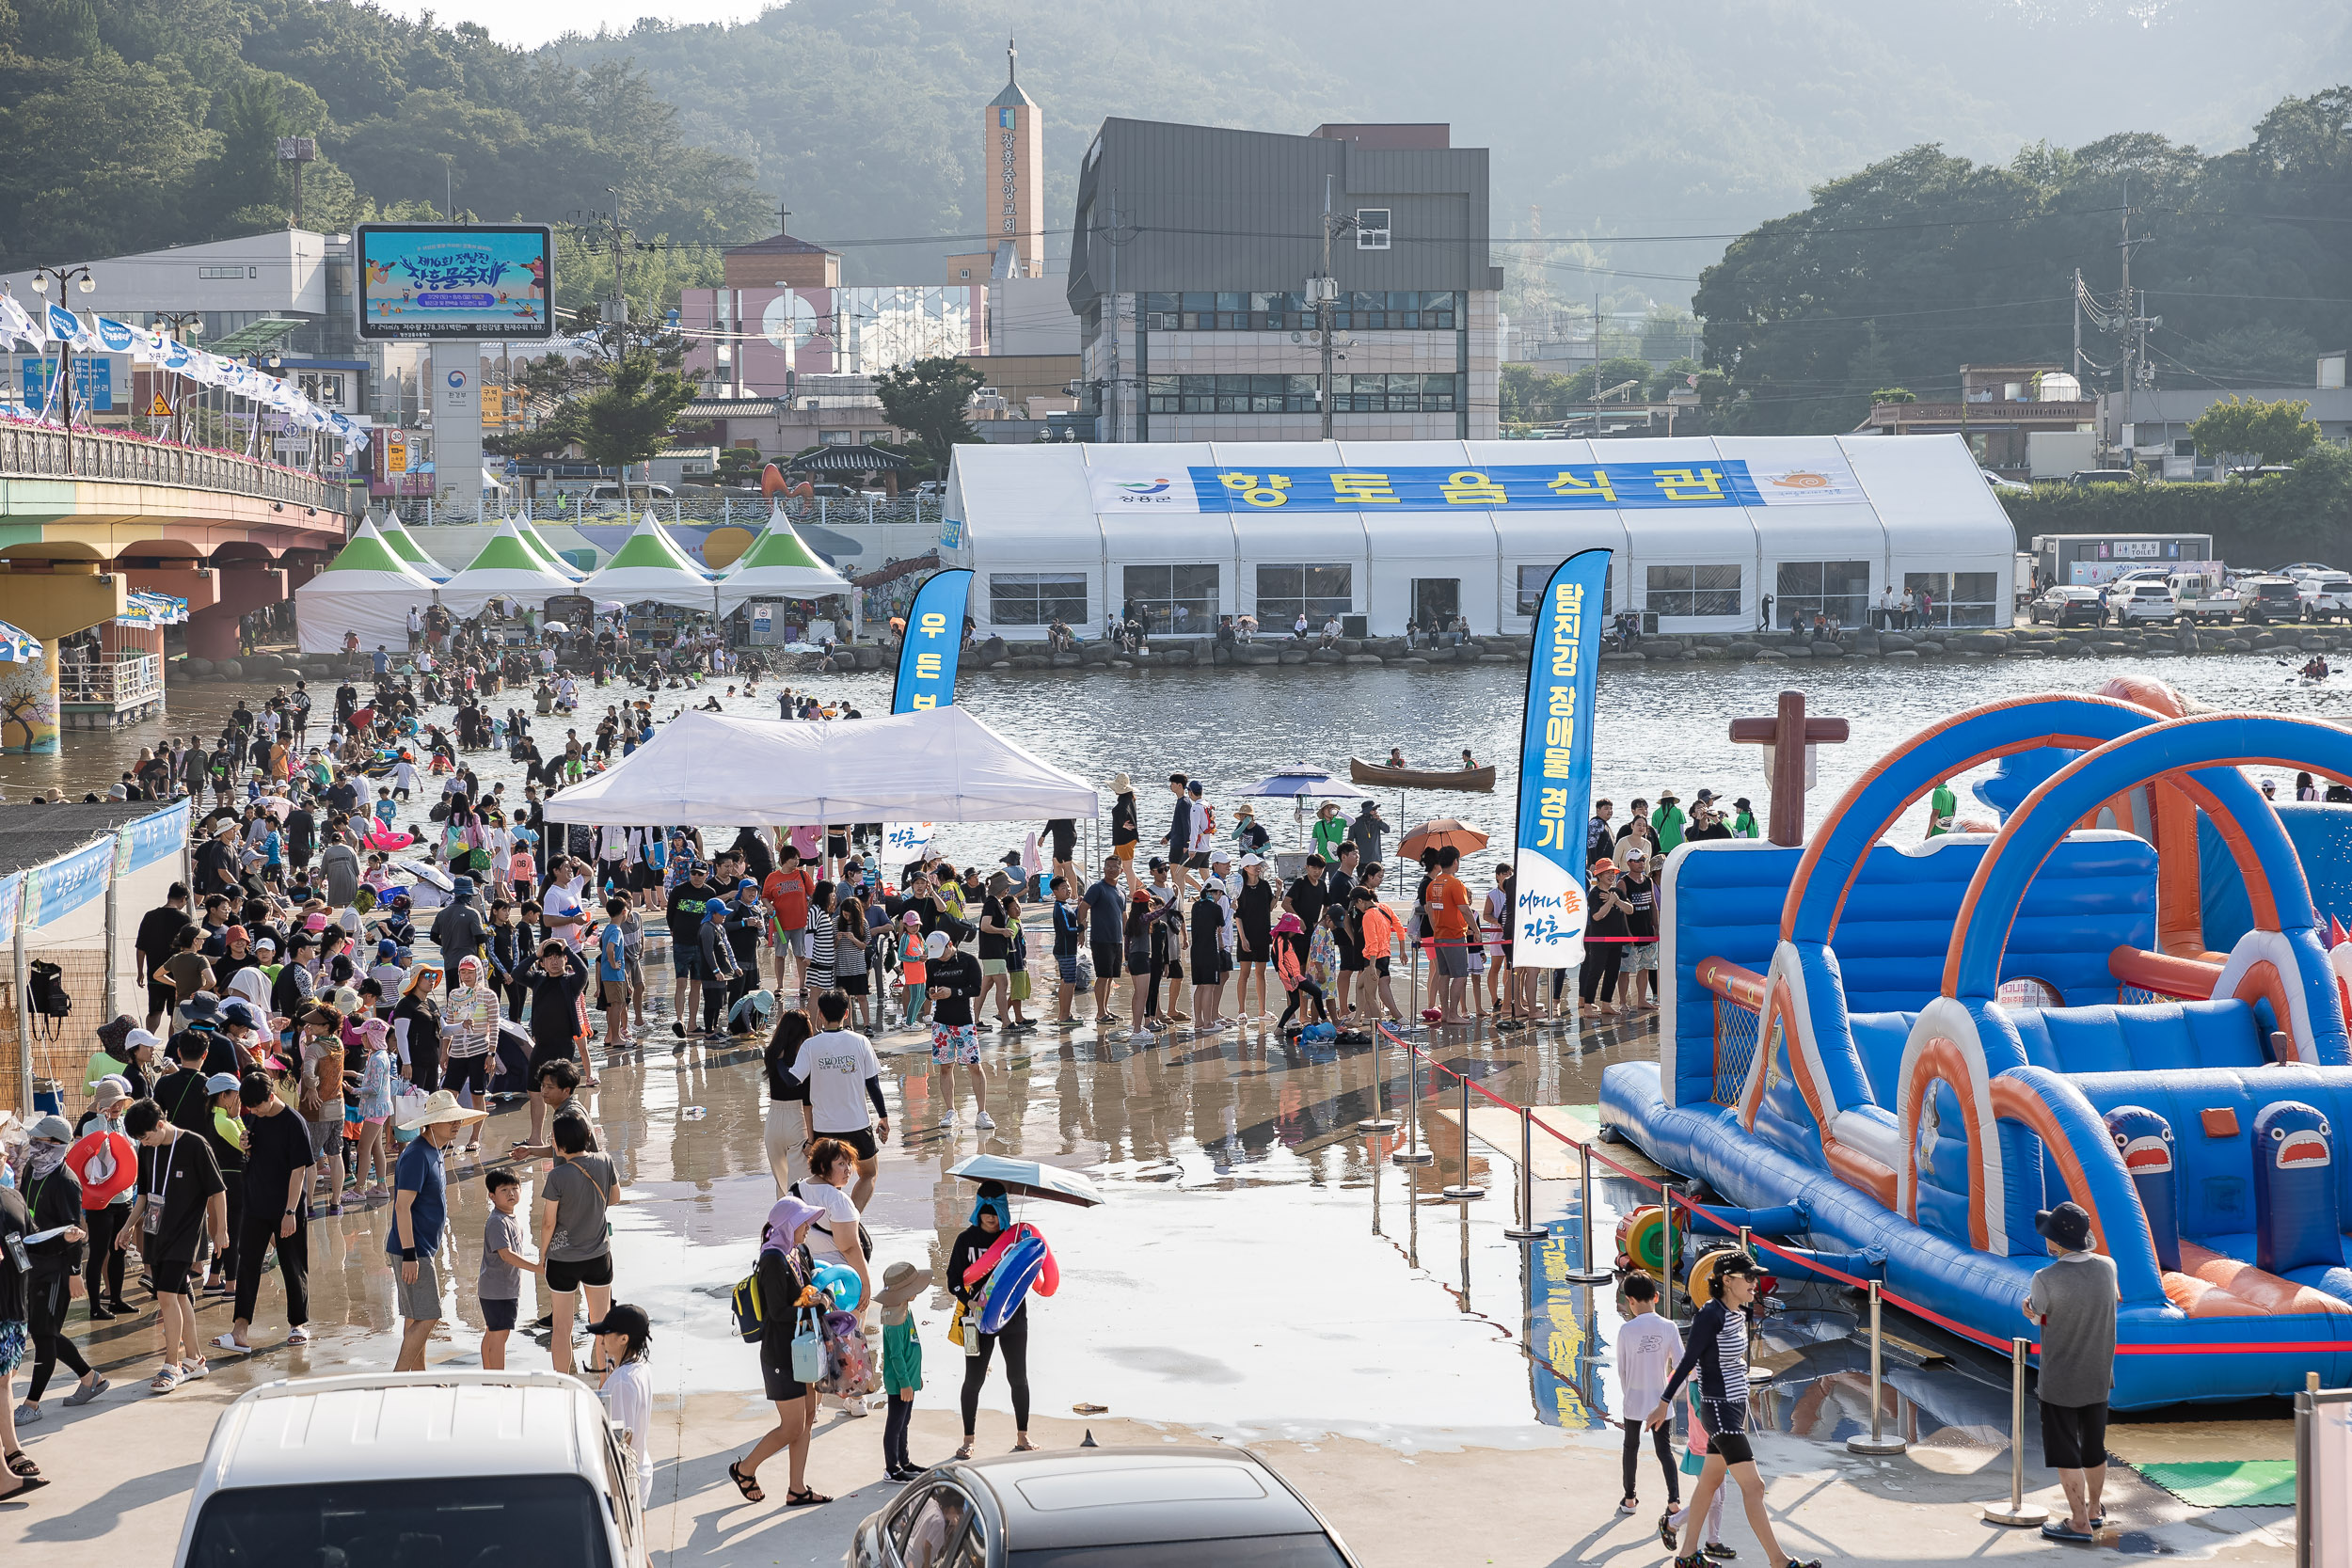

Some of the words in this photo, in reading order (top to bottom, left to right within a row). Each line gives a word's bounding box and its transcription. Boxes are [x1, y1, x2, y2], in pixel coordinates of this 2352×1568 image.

[1001, 134, 1016, 234] 장흥중앙교회
[455, 252, 489, 264] 정남진
[405, 260, 502, 292] 장흥물축제
[1551, 582, 1584, 677] 탐진강
[1543, 686, 1577, 779] 장애물
[1536, 787, 1567, 850] 경기
[889, 827, 930, 849] 장흥
[1518, 889, 1561, 919] 어머니
[1562, 889, 1581, 914] 품
[1523, 917, 1581, 946] 장흥
[818, 1054, 856, 1067] SPORTS
